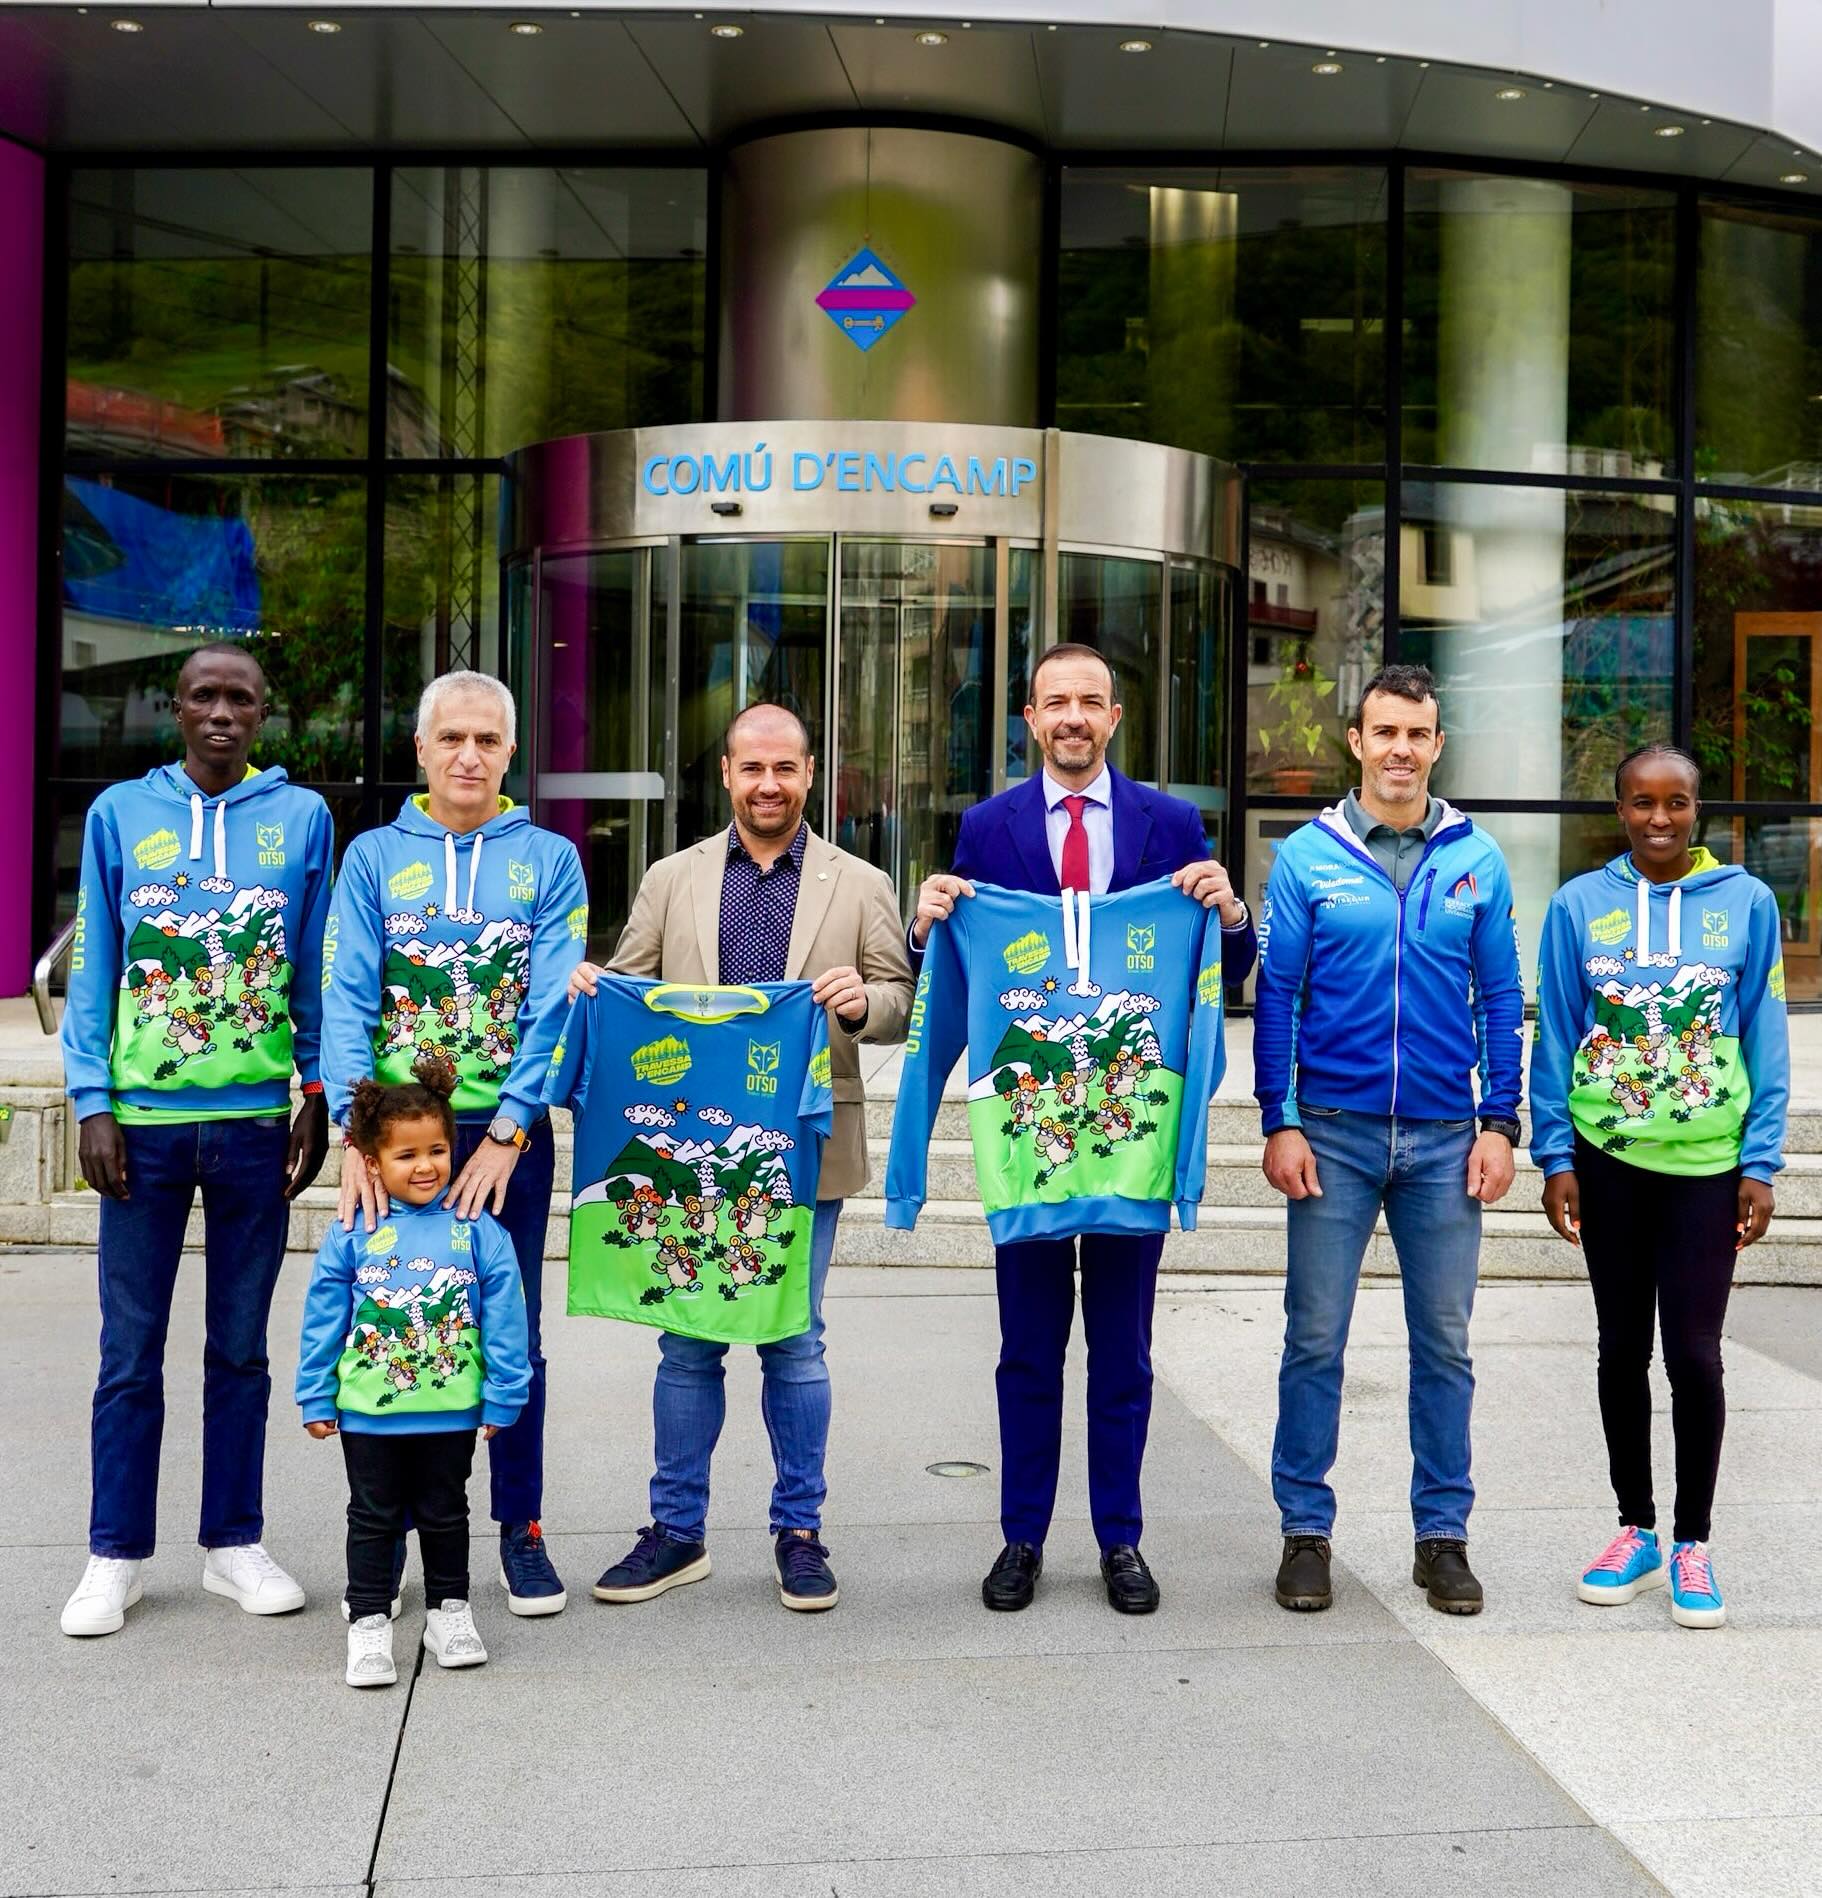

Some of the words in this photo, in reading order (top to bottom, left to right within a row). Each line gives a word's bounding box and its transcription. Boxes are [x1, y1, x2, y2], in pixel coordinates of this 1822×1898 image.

[643, 442, 772, 495] COMÚ
[793, 452, 1037, 497] D'ENCAMP
[258, 851, 286, 866] OTSO
[509, 885, 536, 902] OTSO
[1702, 933, 1729, 948] OTSO
[1127, 954, 1154, 970] OTSO
[635, 1055, 692, 1074] TRAVESSA
[636, 1061, 693, 1081] D'ENCAMP
[747, 1074, 777, 1094] OTSO
[451, 1239, 471, 1251] OTSO
